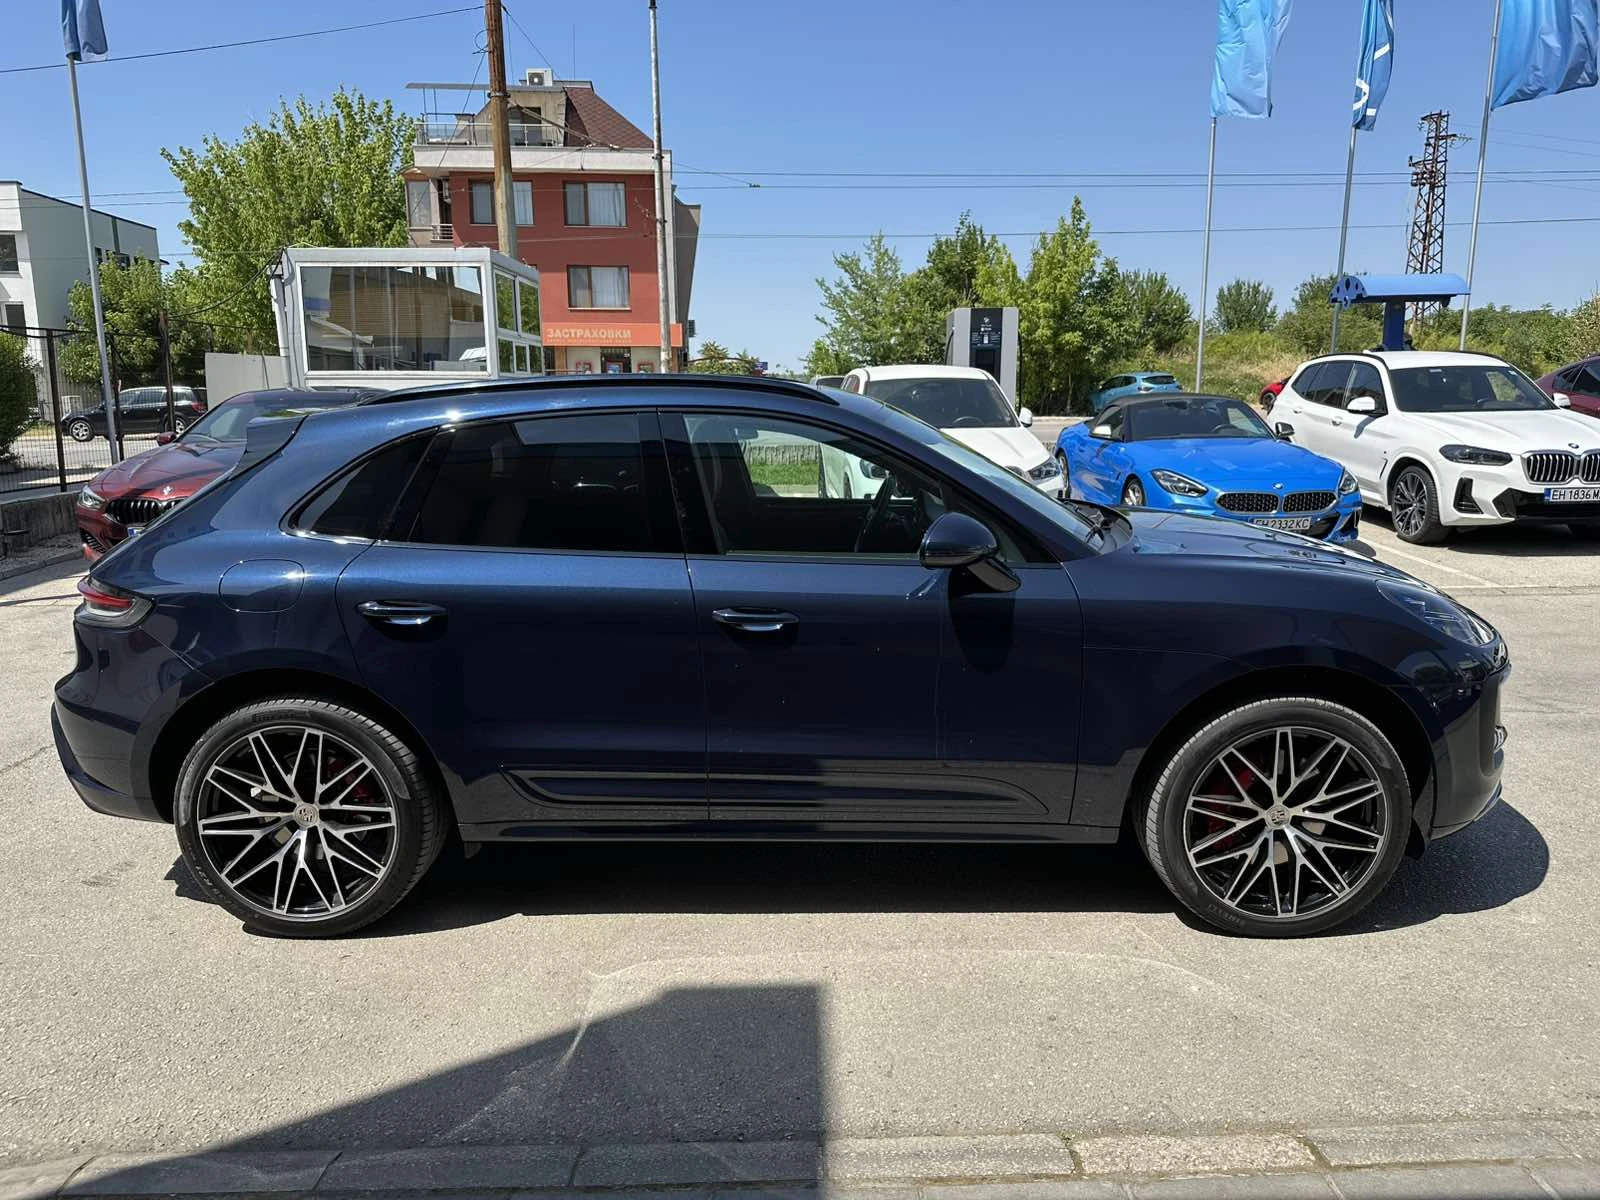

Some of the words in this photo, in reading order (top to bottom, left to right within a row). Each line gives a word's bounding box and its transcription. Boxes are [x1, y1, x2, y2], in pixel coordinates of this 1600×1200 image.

[547, 328, 632, 338] ЗАСТРАХОВКИ
[1552, 489, 1566, 500] EH
[1569, 489, 1591, 500] 1836
[1593, 489, 1600, 500] M
[1295, 518, 1309, 529] KC
